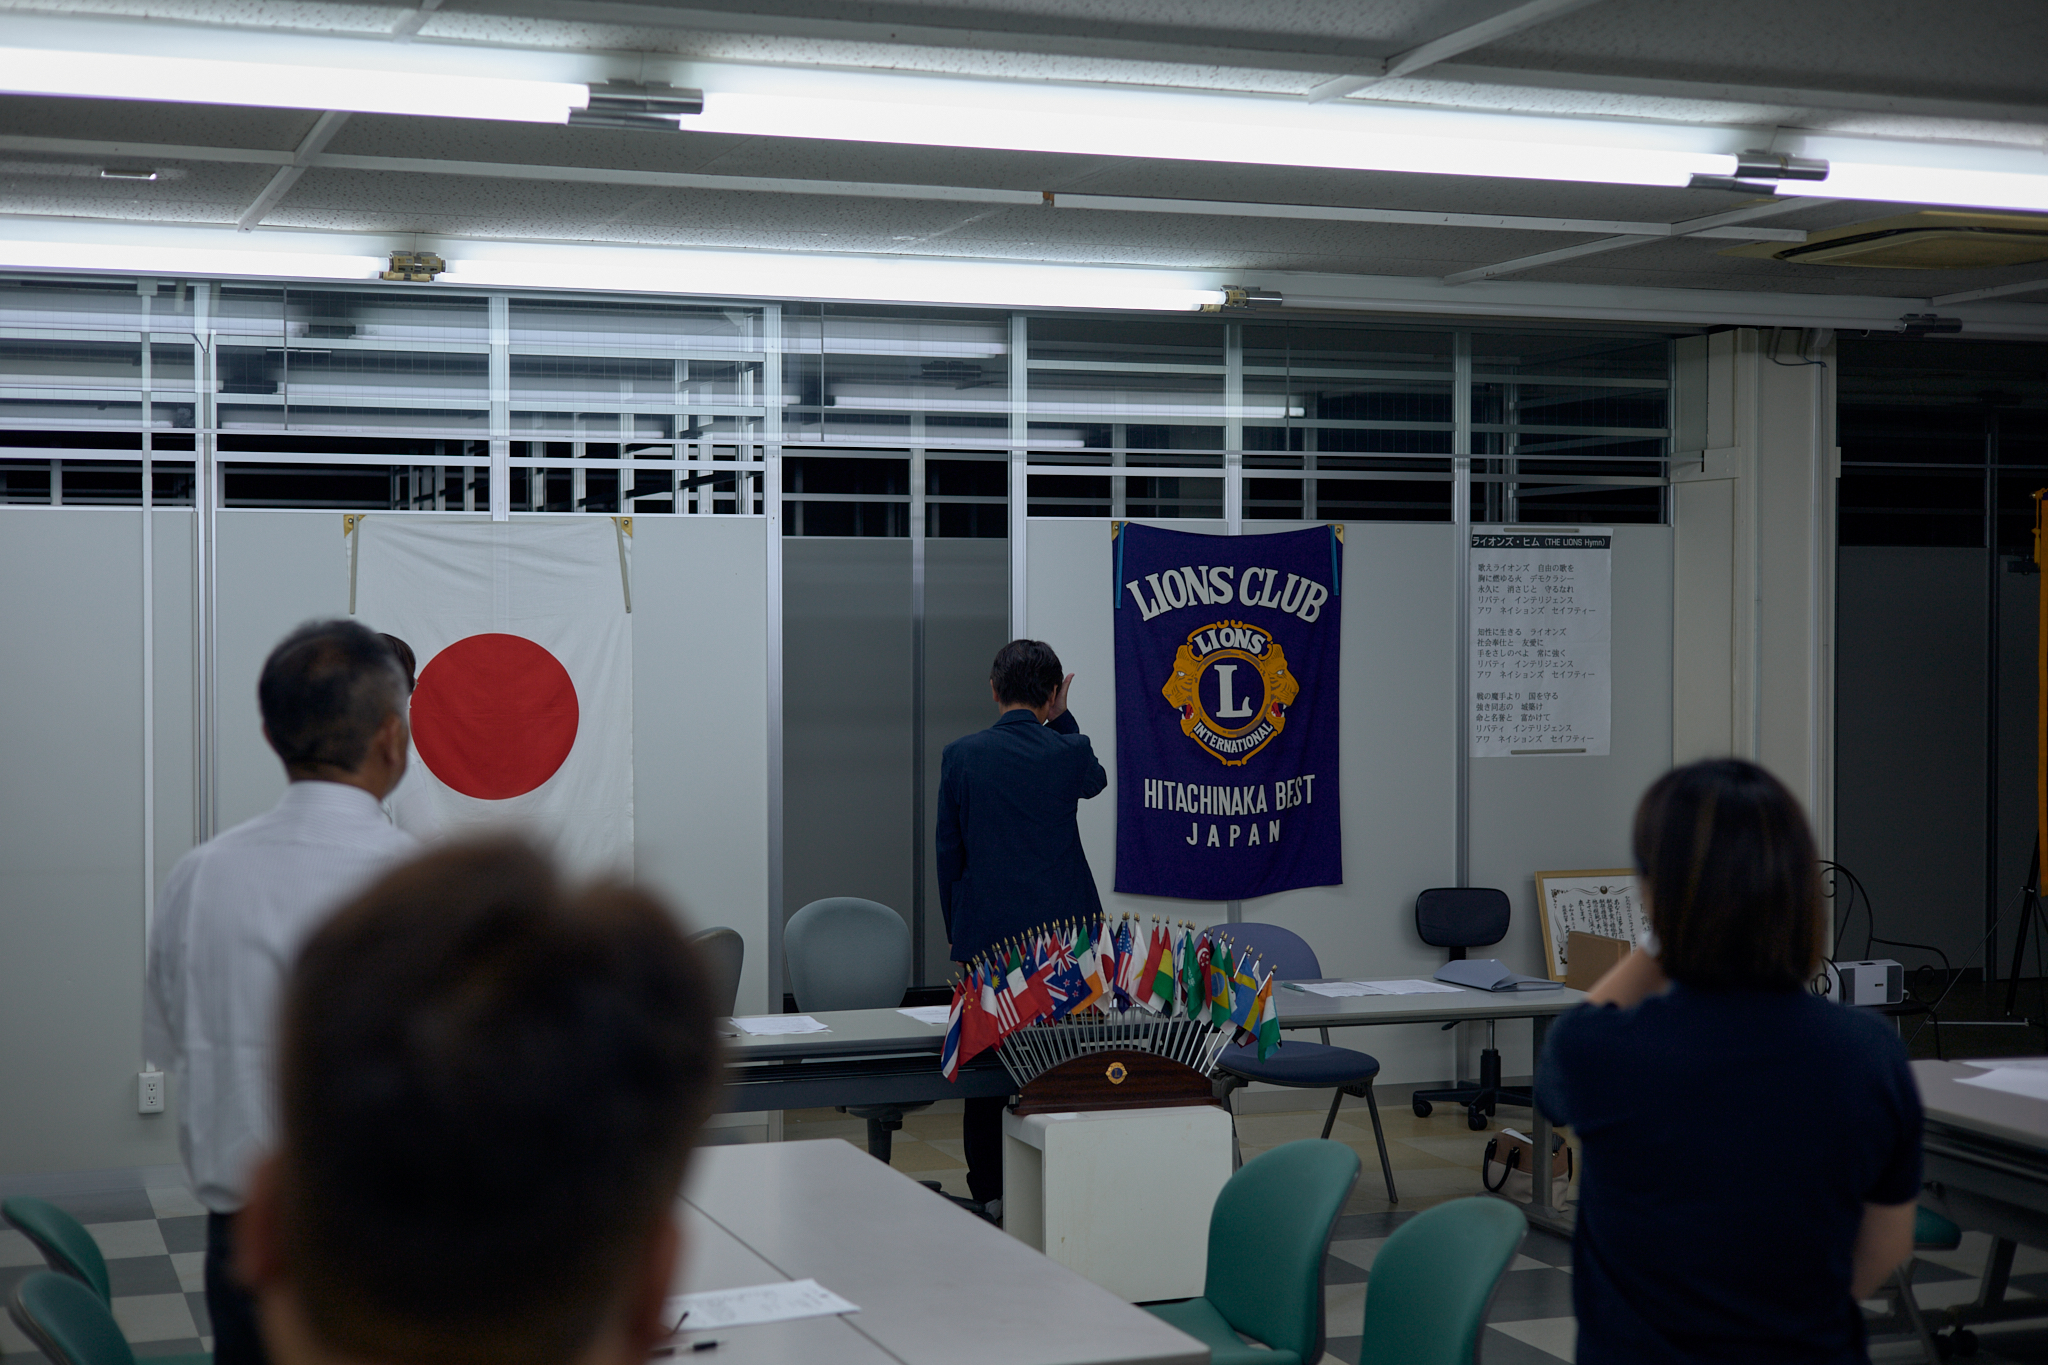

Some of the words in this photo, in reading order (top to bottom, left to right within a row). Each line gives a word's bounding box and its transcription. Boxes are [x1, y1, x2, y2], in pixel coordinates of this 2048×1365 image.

[1563, 538, 1582, 546] LIONS
[1477, 563, 1530, 572] 歌えライオンズ
[1538, 563, 1575, 573] 自由の歌を
[1530, 574, 1574, 583] デモクラシー
[1477, 585, 1499, 594] 永久に
[1544, 585, 1574, 594] 守るなれ
[1126, 565, 1235, 622] LIONS
[1239, 566, 1329, 624] CLUB
[1478, 596, 1506, 604] リバティ
[1514, 596, 1574, 604] インテリジェンス
[1477, 607, 1492, 615] アワ
[1499, 606, 1545, 615] ネイションズ
[1551, 607, 1596, 615] セイフティー
[1477, 627, 1522, 636] 知性に生きる
[1530, 627, 1567, 636] ライオンズ
[1193, 627, 1266, 656] LIONS
[1477, 639, 1514, 647] 社会奉仕と
[1521, 639, 1544, 647] 友愛に
[1477, 649, 1529, 658] 手をさしのべよ
[1537, 649, 1566, 658] 常に強く
[1477, 660, 1506, 668] リバティ
[1514, 660, 1574, 668] インテリジェンス
[1477, 670, 1491, 679] アワ
[1499, 670, 1544, 679] ネイションズ
[1551, 670, 1595, 679] セイフティー
[1214, 664, 1254, 718] L
[1528, 692, 1559, 700] 国を守る
[1476, 703, 1513, 711] 強き同志の
[1476, 724, 1504, 732] リバティ
[1513, 724, 1572, 732] インテリジェンス
[1192, 722, 1274, 754] INTERNATIONAL
[1475, 735, 1490, 743] アワ
[1498, 735, 1543, 743] ネイションズ
[1550, 735, 1594, 743] セイフティー
[1144, 778, 1268, 816] HITACHINAKA
[1275, 774, 1316, 812] BEST
[1186, 819, 1281, 848] JAPAN
